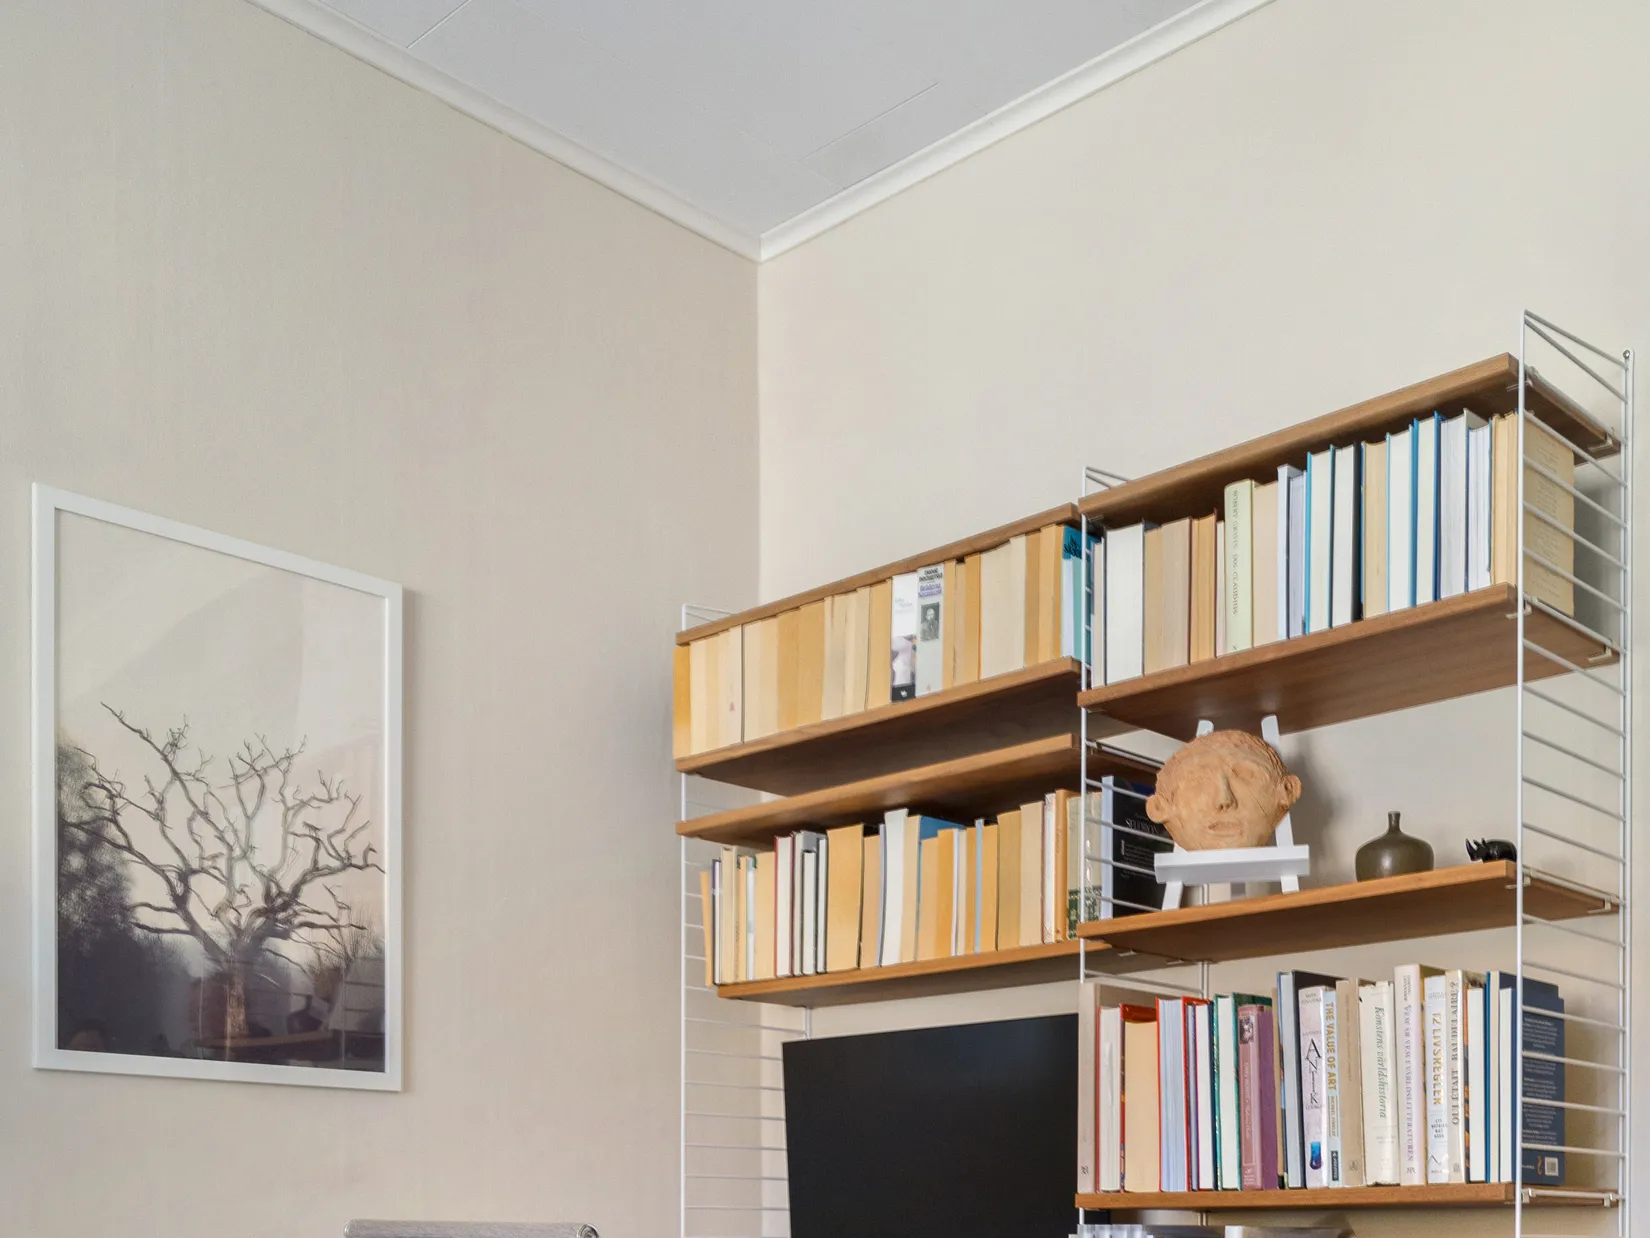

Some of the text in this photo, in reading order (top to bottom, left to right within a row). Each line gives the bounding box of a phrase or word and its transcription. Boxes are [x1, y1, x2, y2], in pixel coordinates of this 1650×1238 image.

[1325, 1002, 1337, 1091] THE VALUE OF ART
[1374, 1006, 1387, 1049] Konstens
[1376, 1051, 1389, 1119] världshistoria
[1432, 1029, 1443, 1105] LIVSREGLER
